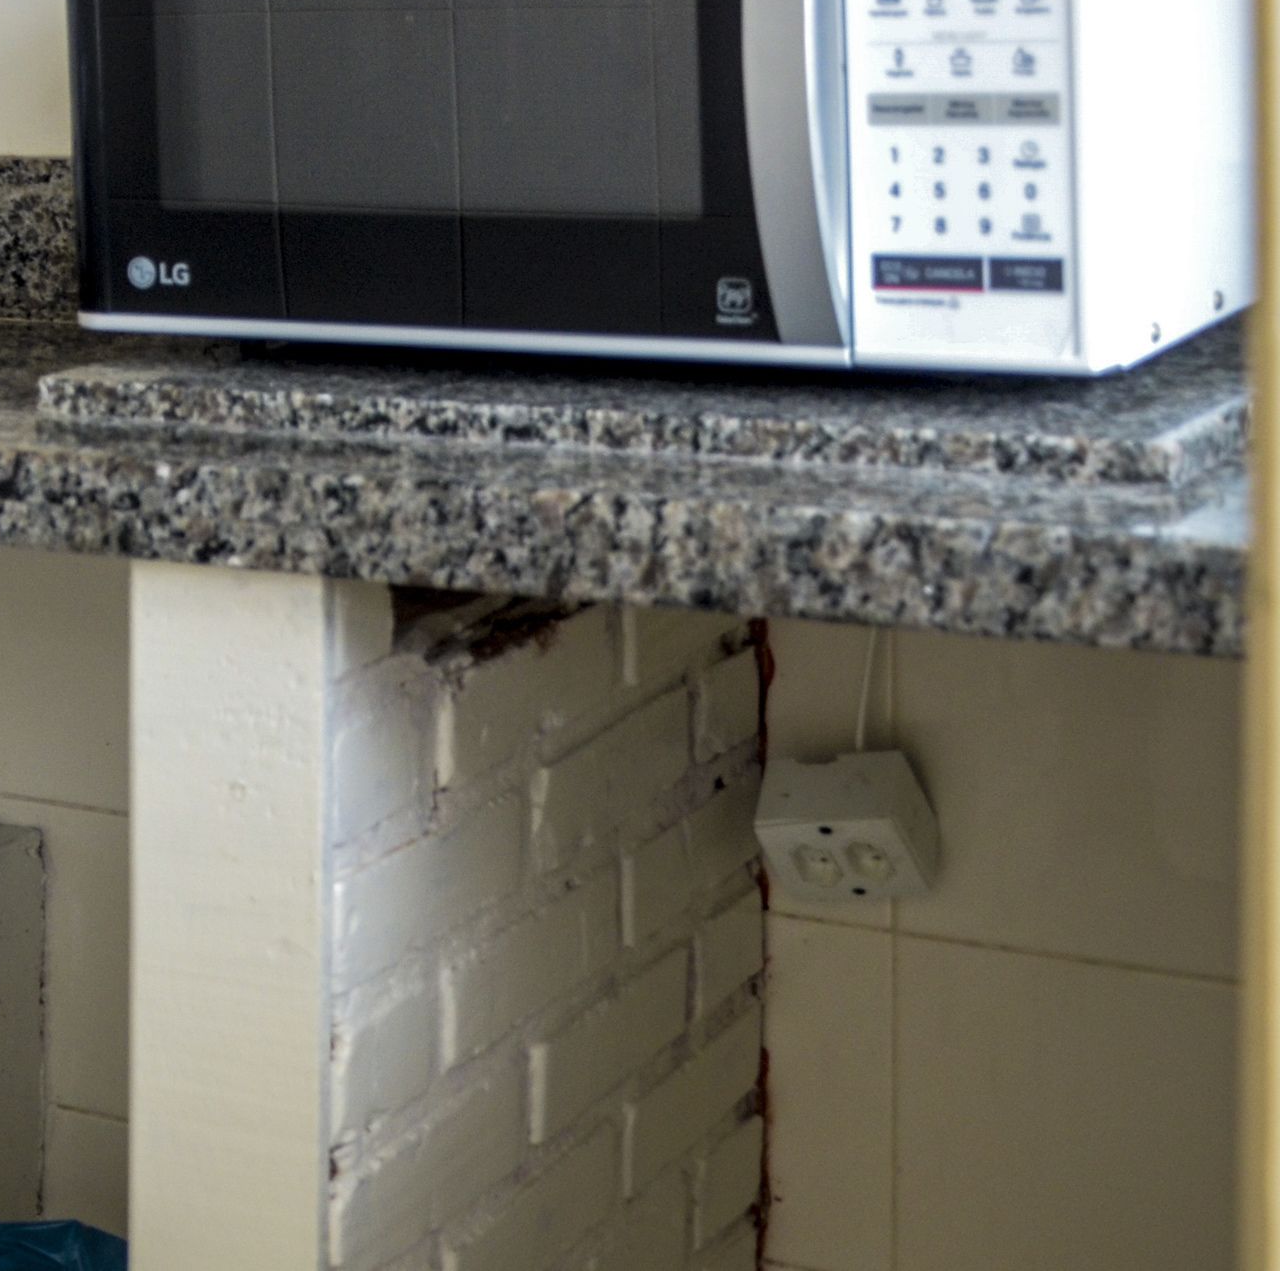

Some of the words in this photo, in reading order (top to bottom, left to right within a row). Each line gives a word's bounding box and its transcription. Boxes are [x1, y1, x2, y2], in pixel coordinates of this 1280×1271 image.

[891, 146, 899, 164] 1
[933, 145, 944, 165] 2
[978, 146, 990, 165] 3
[889, 183, 901, 199] 4
[934, 181, 946, 200] 5
[978, 182, 991, 201] 6
[1024, 182, 1037, 201] 0
[891, 215, 901, 233] 7
[934, 216, 947, 235] 8
[979, 217, 992, 236] 9
[159, 262, 190, 286] LG
